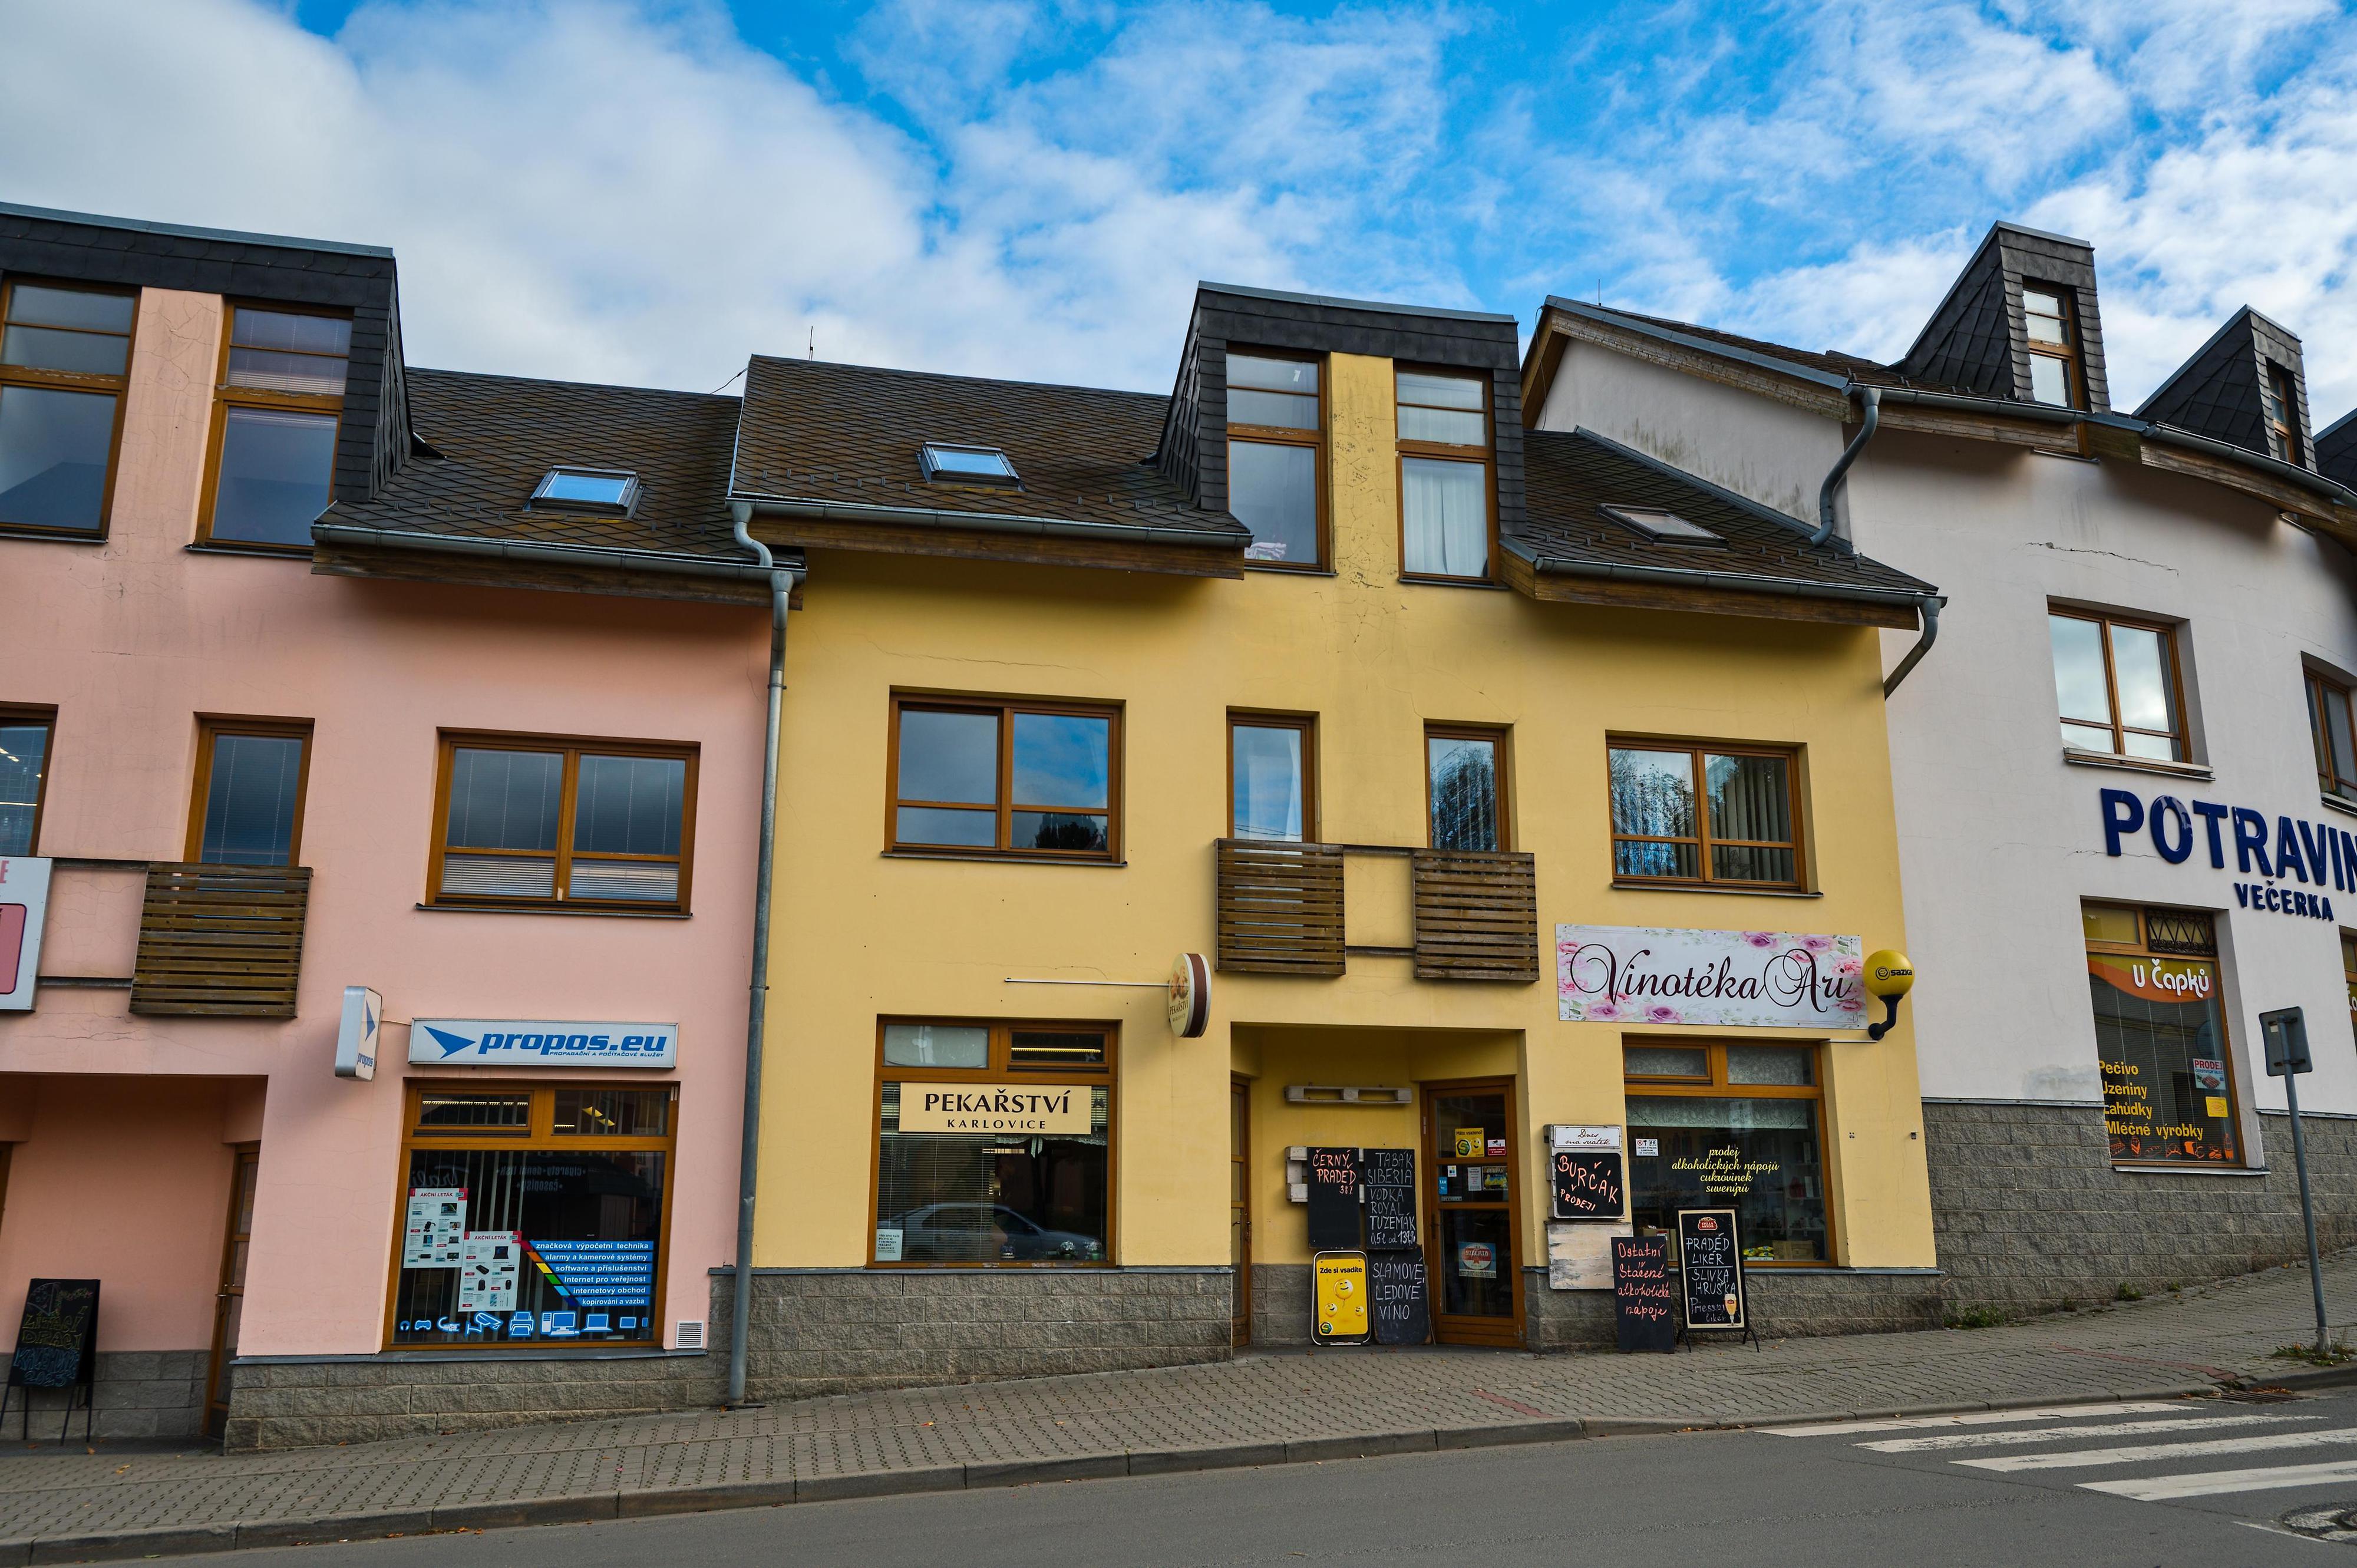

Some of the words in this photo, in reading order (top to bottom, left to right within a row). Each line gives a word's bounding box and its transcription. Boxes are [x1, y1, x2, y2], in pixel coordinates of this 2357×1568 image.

[2234, 880, 2334, 922] VEČERKA
[1570, 943, 1765, 1006] Vinotéka
[1764, 948, 1853, 1013] Ari
[2132, 964, 2145, 988] U
[2151, 958, 2209, 998] Čapků
[478, 1033, 667, 1055] propos.eu
[357, 1052, 374, 1068] propos
[2194, 1059, 2223, 1070] PRODEJ
[925, 1088, 1071, 1114] PEKAŘSTVÍ
[948, 1119, 1046, 1129] KARLOVICE
[2155, 1123, 2204, 1141] výrobky
[1577, 1128, 1599, 1138] Dnes
[1313, 1148, 1352, 1167] ČERNÝ
[1375, 1151, 1414, 1168] TABÁK
[1708, 1145, 1740, 1160] prodej
[1672, 1157, 1742, 1174] alkoholických
[1744, 1160, 1780, 1174] nápojů
[1367, 1168, 1412, 1184] SIBERIA
[1557, 1155, 1618, 1204] BURČÁK
[1700, 1170, 1754, 1182] cukrovinek
[1370, 1188, 1404, 1202] VODKA
[1705, 1182, 1750, 1197] suvenýrů
[1370, 1201, 1405, 1216] ROYAL
[1369, 1212, 1415, 1230] TUZEMÁK
[1618, 1242, 1664, 1258] Ostatní
[1692, 1250, 1724, 1265] LIKÉR
[1691, 1269, 1729, 1283] SLIVKA
[1376, 1281, 1422, 1300] LEDOVÉ
[1695, 1282, 1736, 1295] HRUŠKA
[1379, 1300, 1410, 1320] VÍNO
[1626, 1299, 1667, 1321] nápoje
